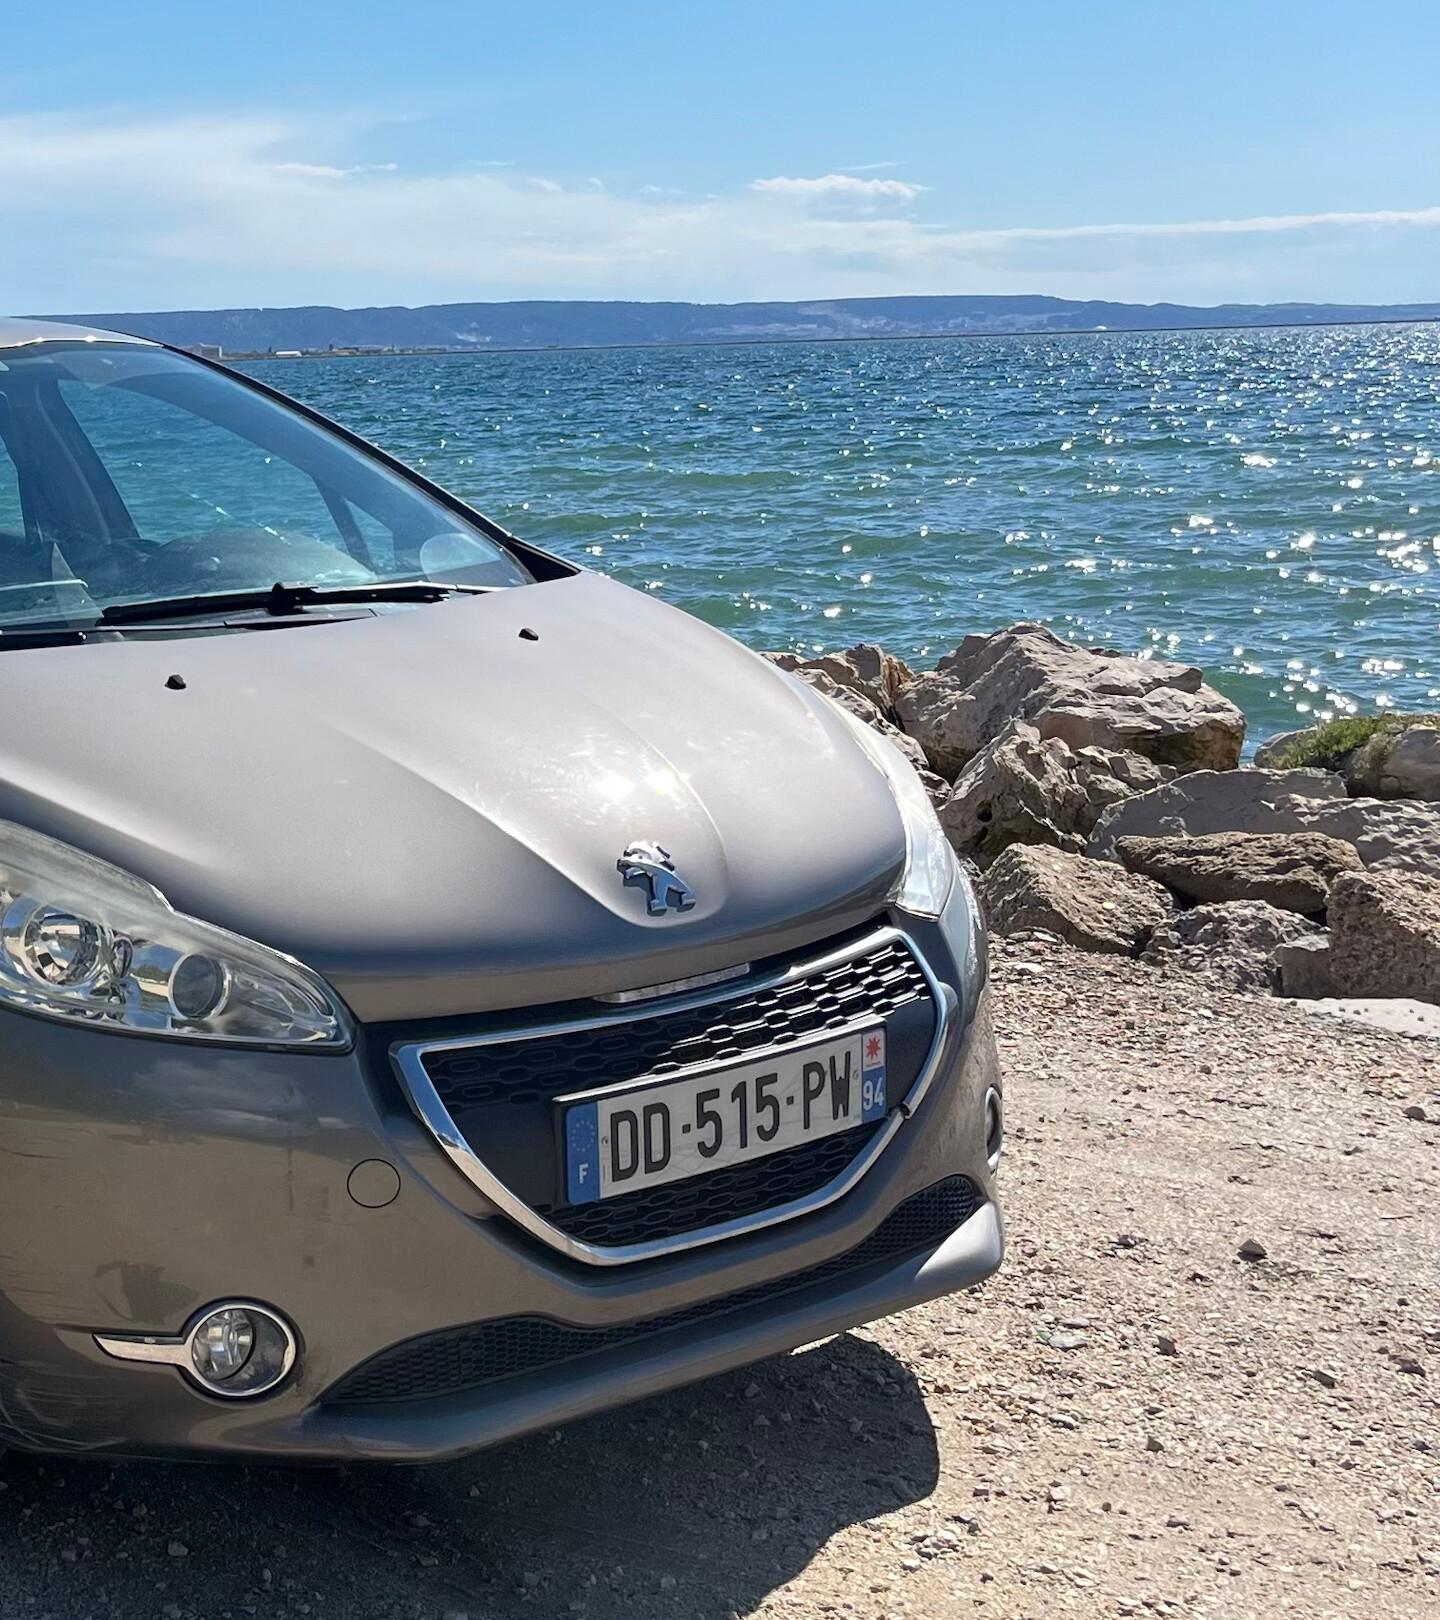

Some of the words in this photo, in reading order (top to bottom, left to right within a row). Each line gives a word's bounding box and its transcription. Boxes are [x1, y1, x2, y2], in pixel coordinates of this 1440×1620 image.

[863, 1078, 884, 1110] 94
[610, 1051, 851, 1182] DD-515-PW
[579, 1163, 589, 1184] F
